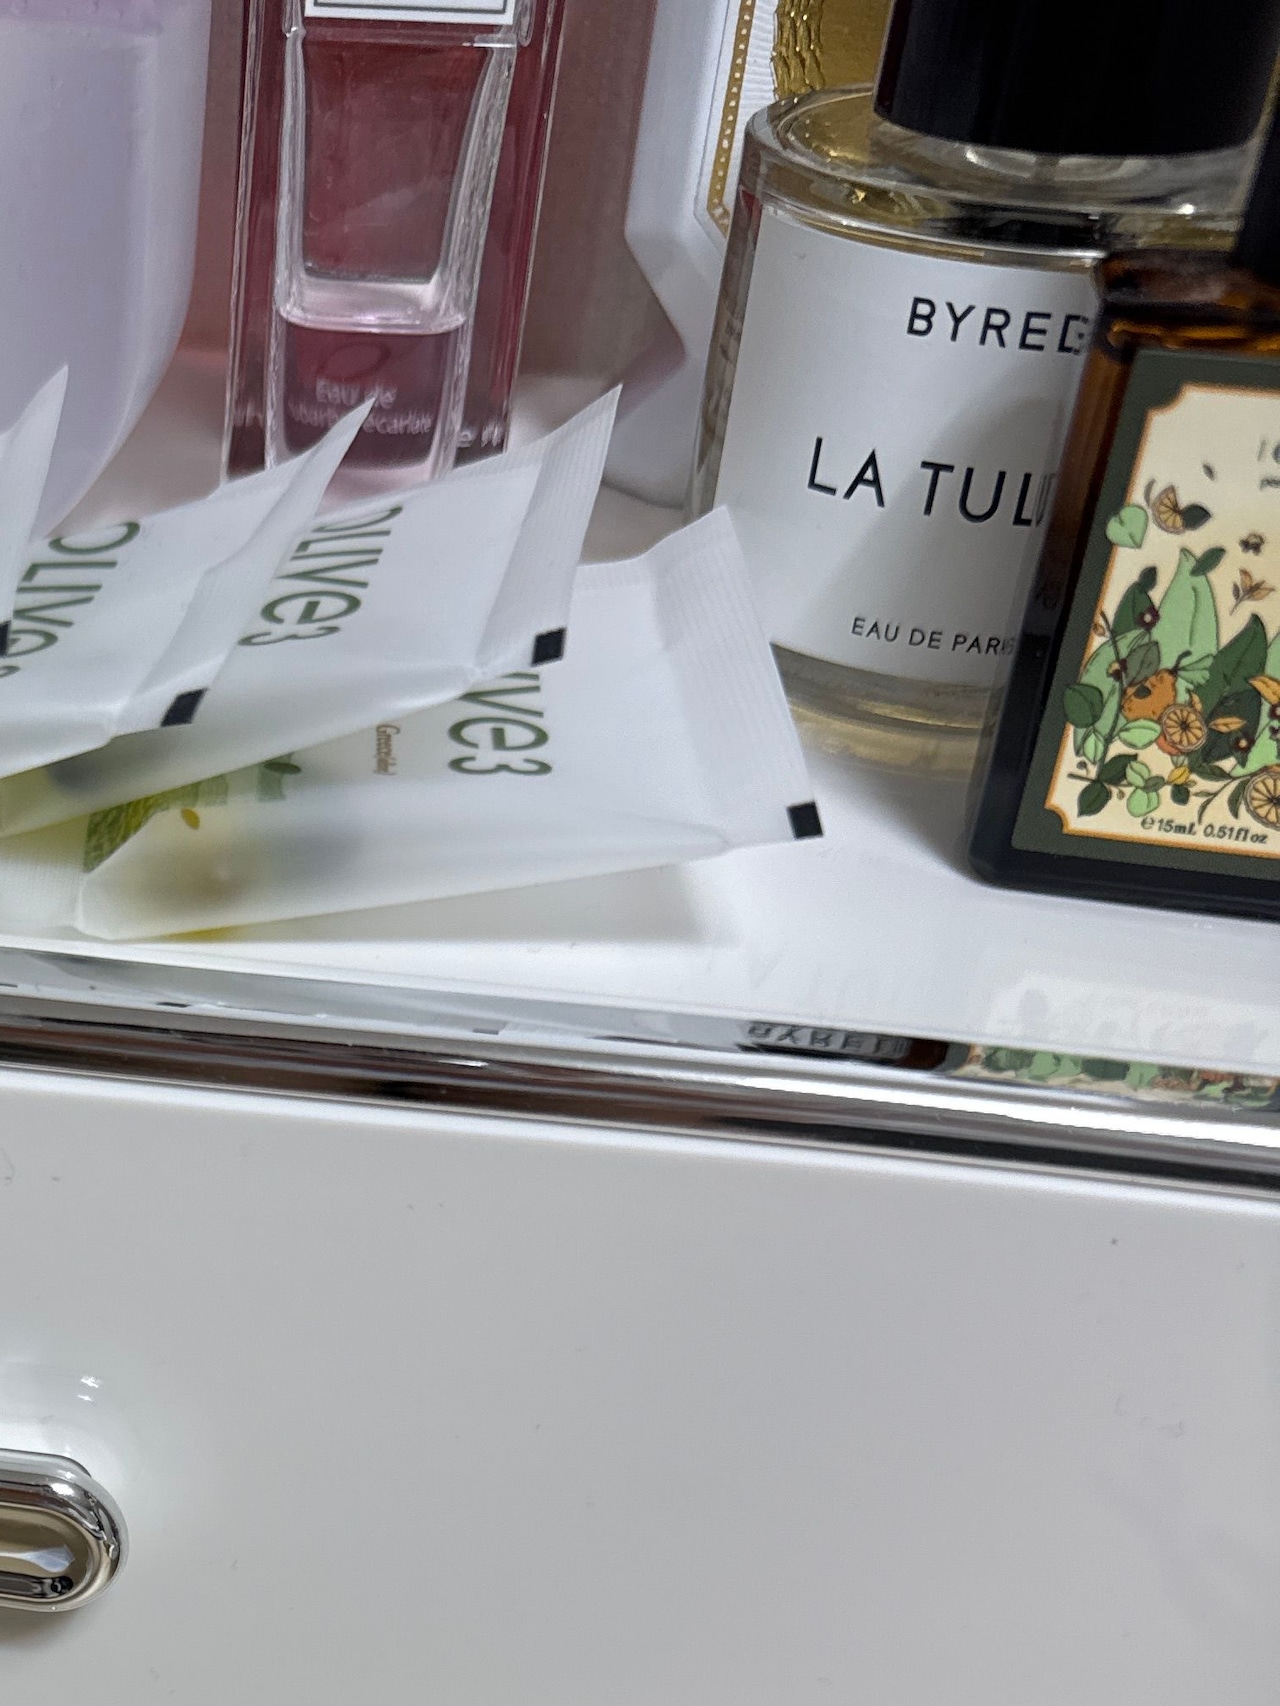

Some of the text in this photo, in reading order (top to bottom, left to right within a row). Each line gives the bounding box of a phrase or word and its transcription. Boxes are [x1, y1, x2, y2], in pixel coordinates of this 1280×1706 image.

[807, 436, 1055, 528] LA TUL
[851, 617, 900, 643] EAU
[909, 629, 942, 649] DE
